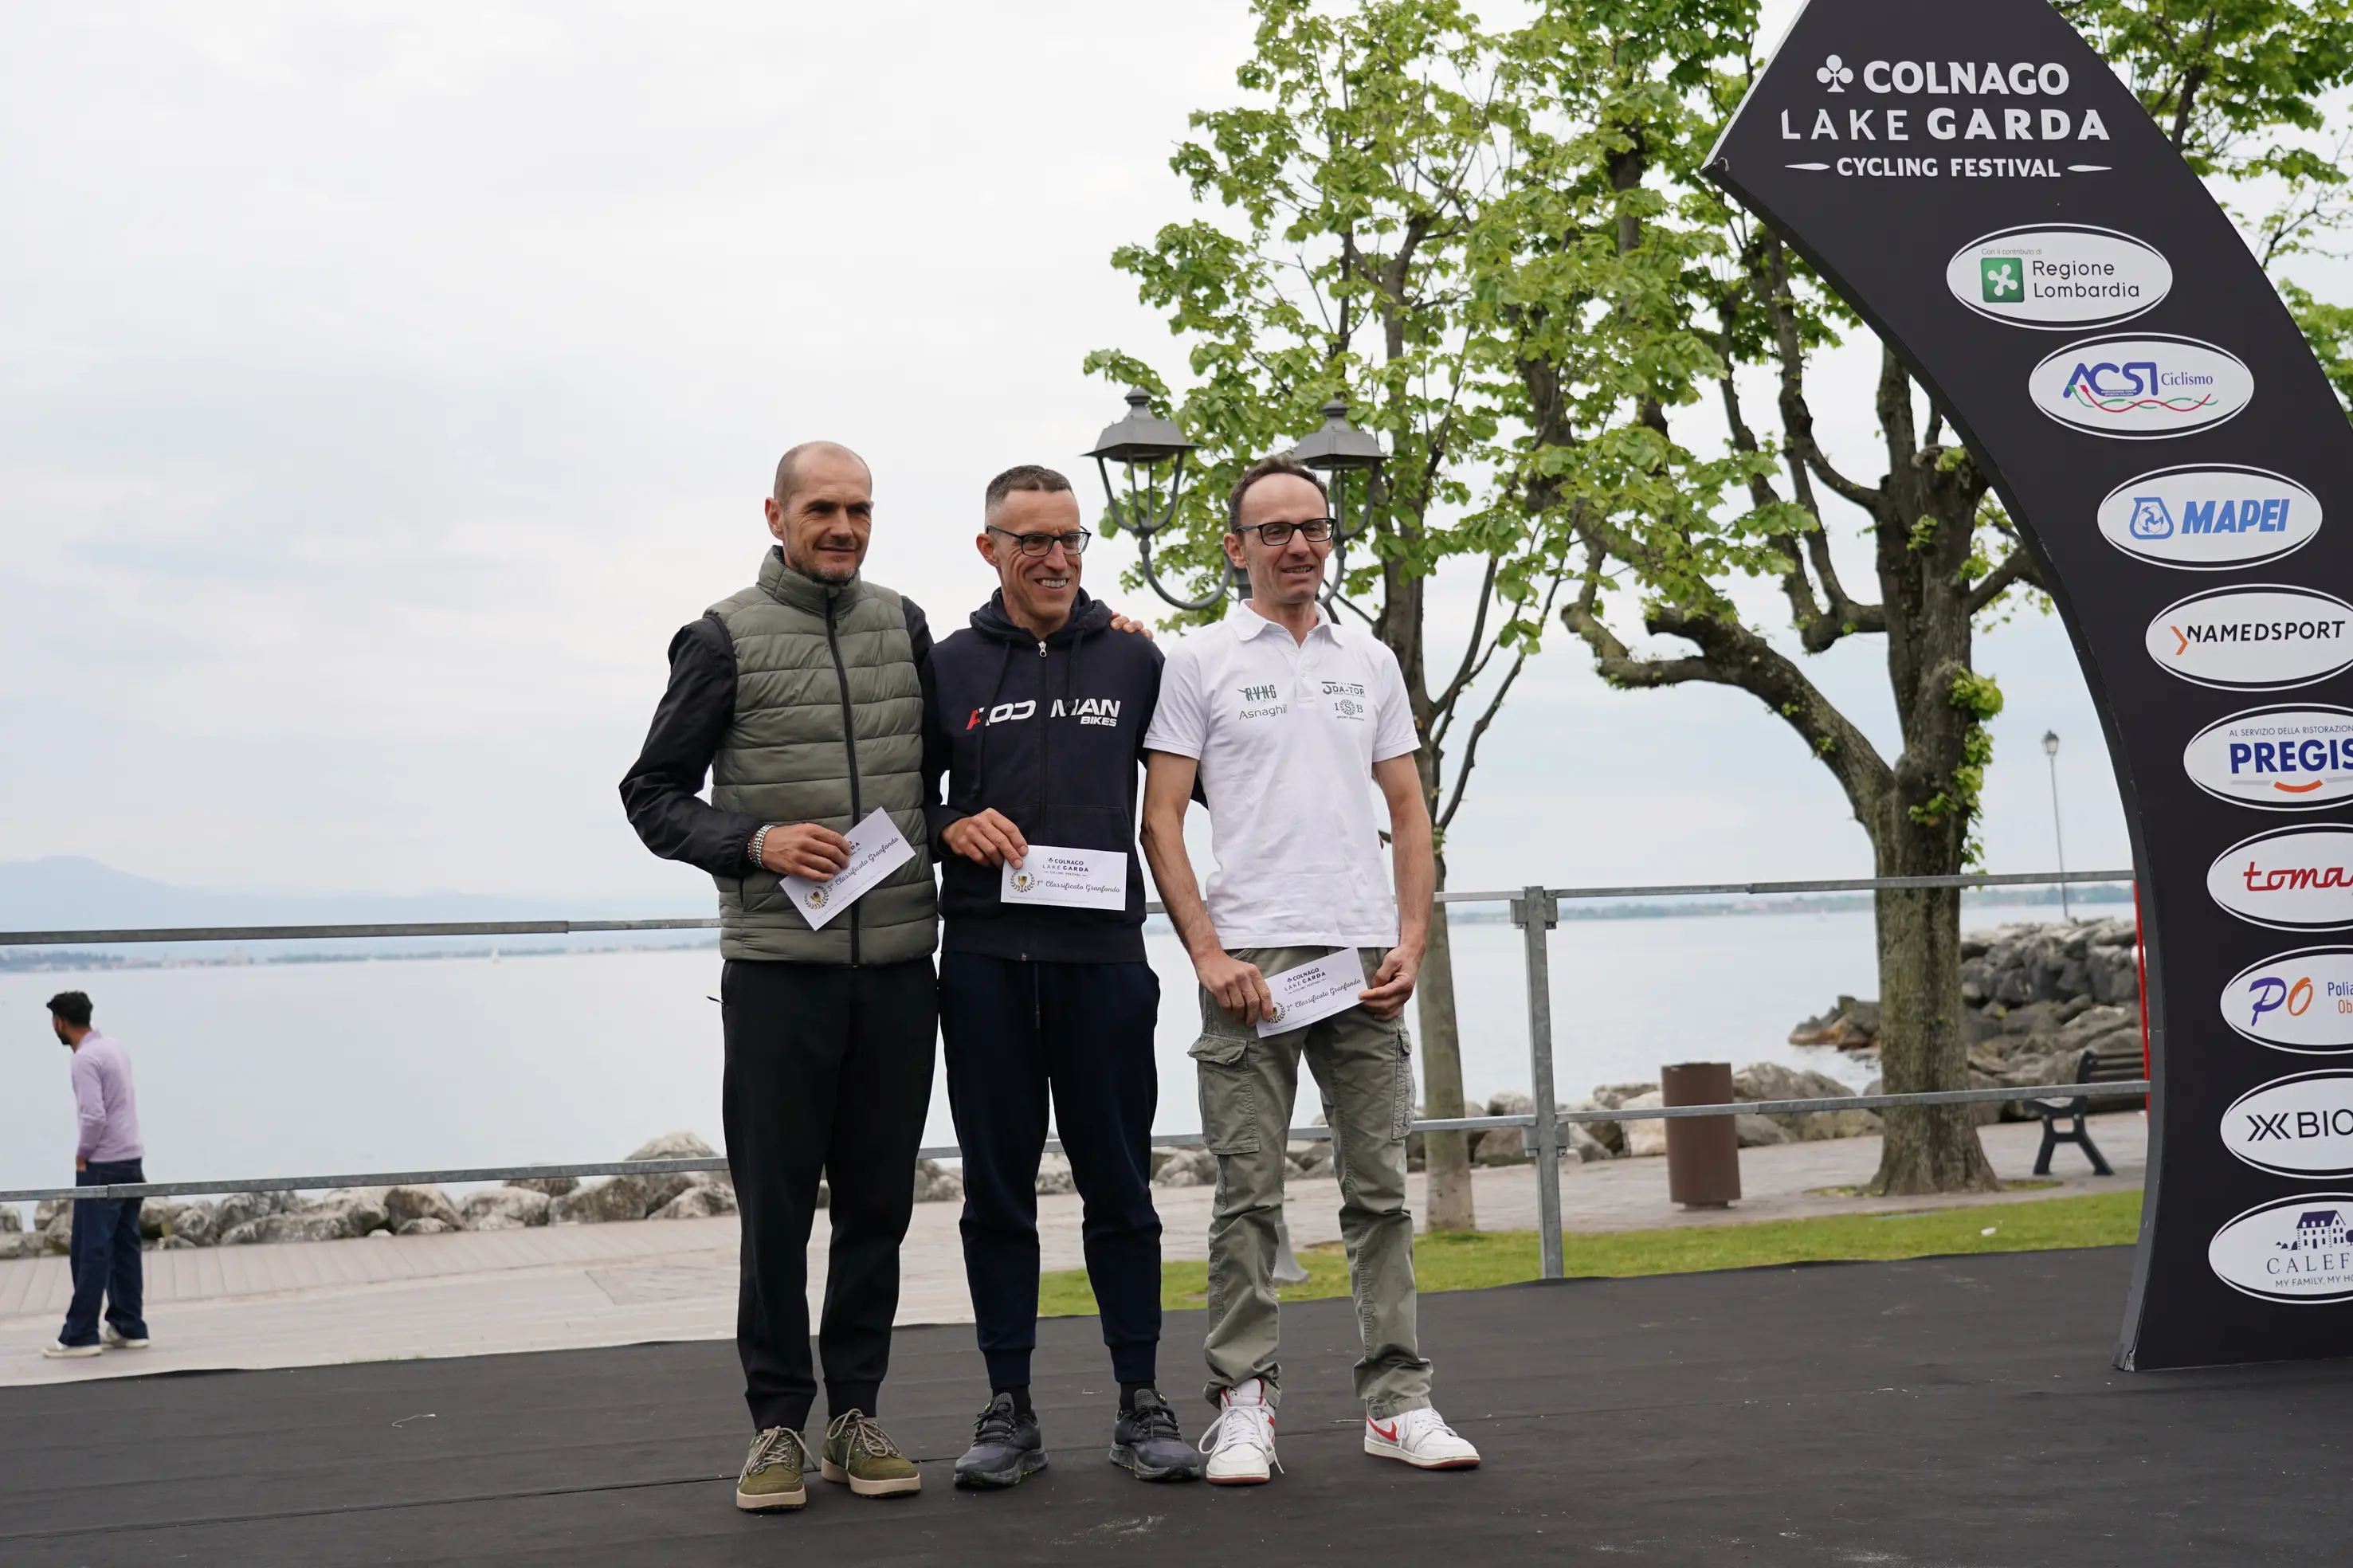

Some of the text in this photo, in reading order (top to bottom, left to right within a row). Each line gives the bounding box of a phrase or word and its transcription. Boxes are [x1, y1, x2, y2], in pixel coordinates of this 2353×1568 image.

[1863, 61, 2070, 95] COLNAGO
[1781, 108, 2111, 140] LAKE GARDA
[1837, 157, 2061, 177] CYCLING FESTIVAL
[2033, 261, 2115, 280] Regione
[2034, 282, 2139, 298] Lombardia
[2063, 362, 2214, 398] ACSI Ciclismo
[2181, 499, 2290, 535] MAPEI
[2186, 621, 2345, 643] NAMEDSPORT
[1080, 716, 1117, 727] BIKES
[1239, 704, 1286, 720] Asnaghi
[2241, 727, 2275, 736] SERVIZIO
[835, 860, 869, 885] Classificato
[868, 837, 899, 862] Granfondo
[2243, 861, 2353, 892] toma
[1045, 880, 1084, 891] Classificato
[1085, 884, 1120, 893] Granfondo
[1284, 972, 1326, 991] LAKE GARDA
[1292, 967, 1320, 981] COLNAGO
[1295, 991, 1329, 1008] Classificato
[1330, 978, 1361, 995] Granfondo
[2338, 999, 2353, 1013] Ob
[2267, 1252, 2350, 1274] CALEF
[2276, 1279, 2288, 1288] MY
[2327, 1275, 2341, 1284] MY
